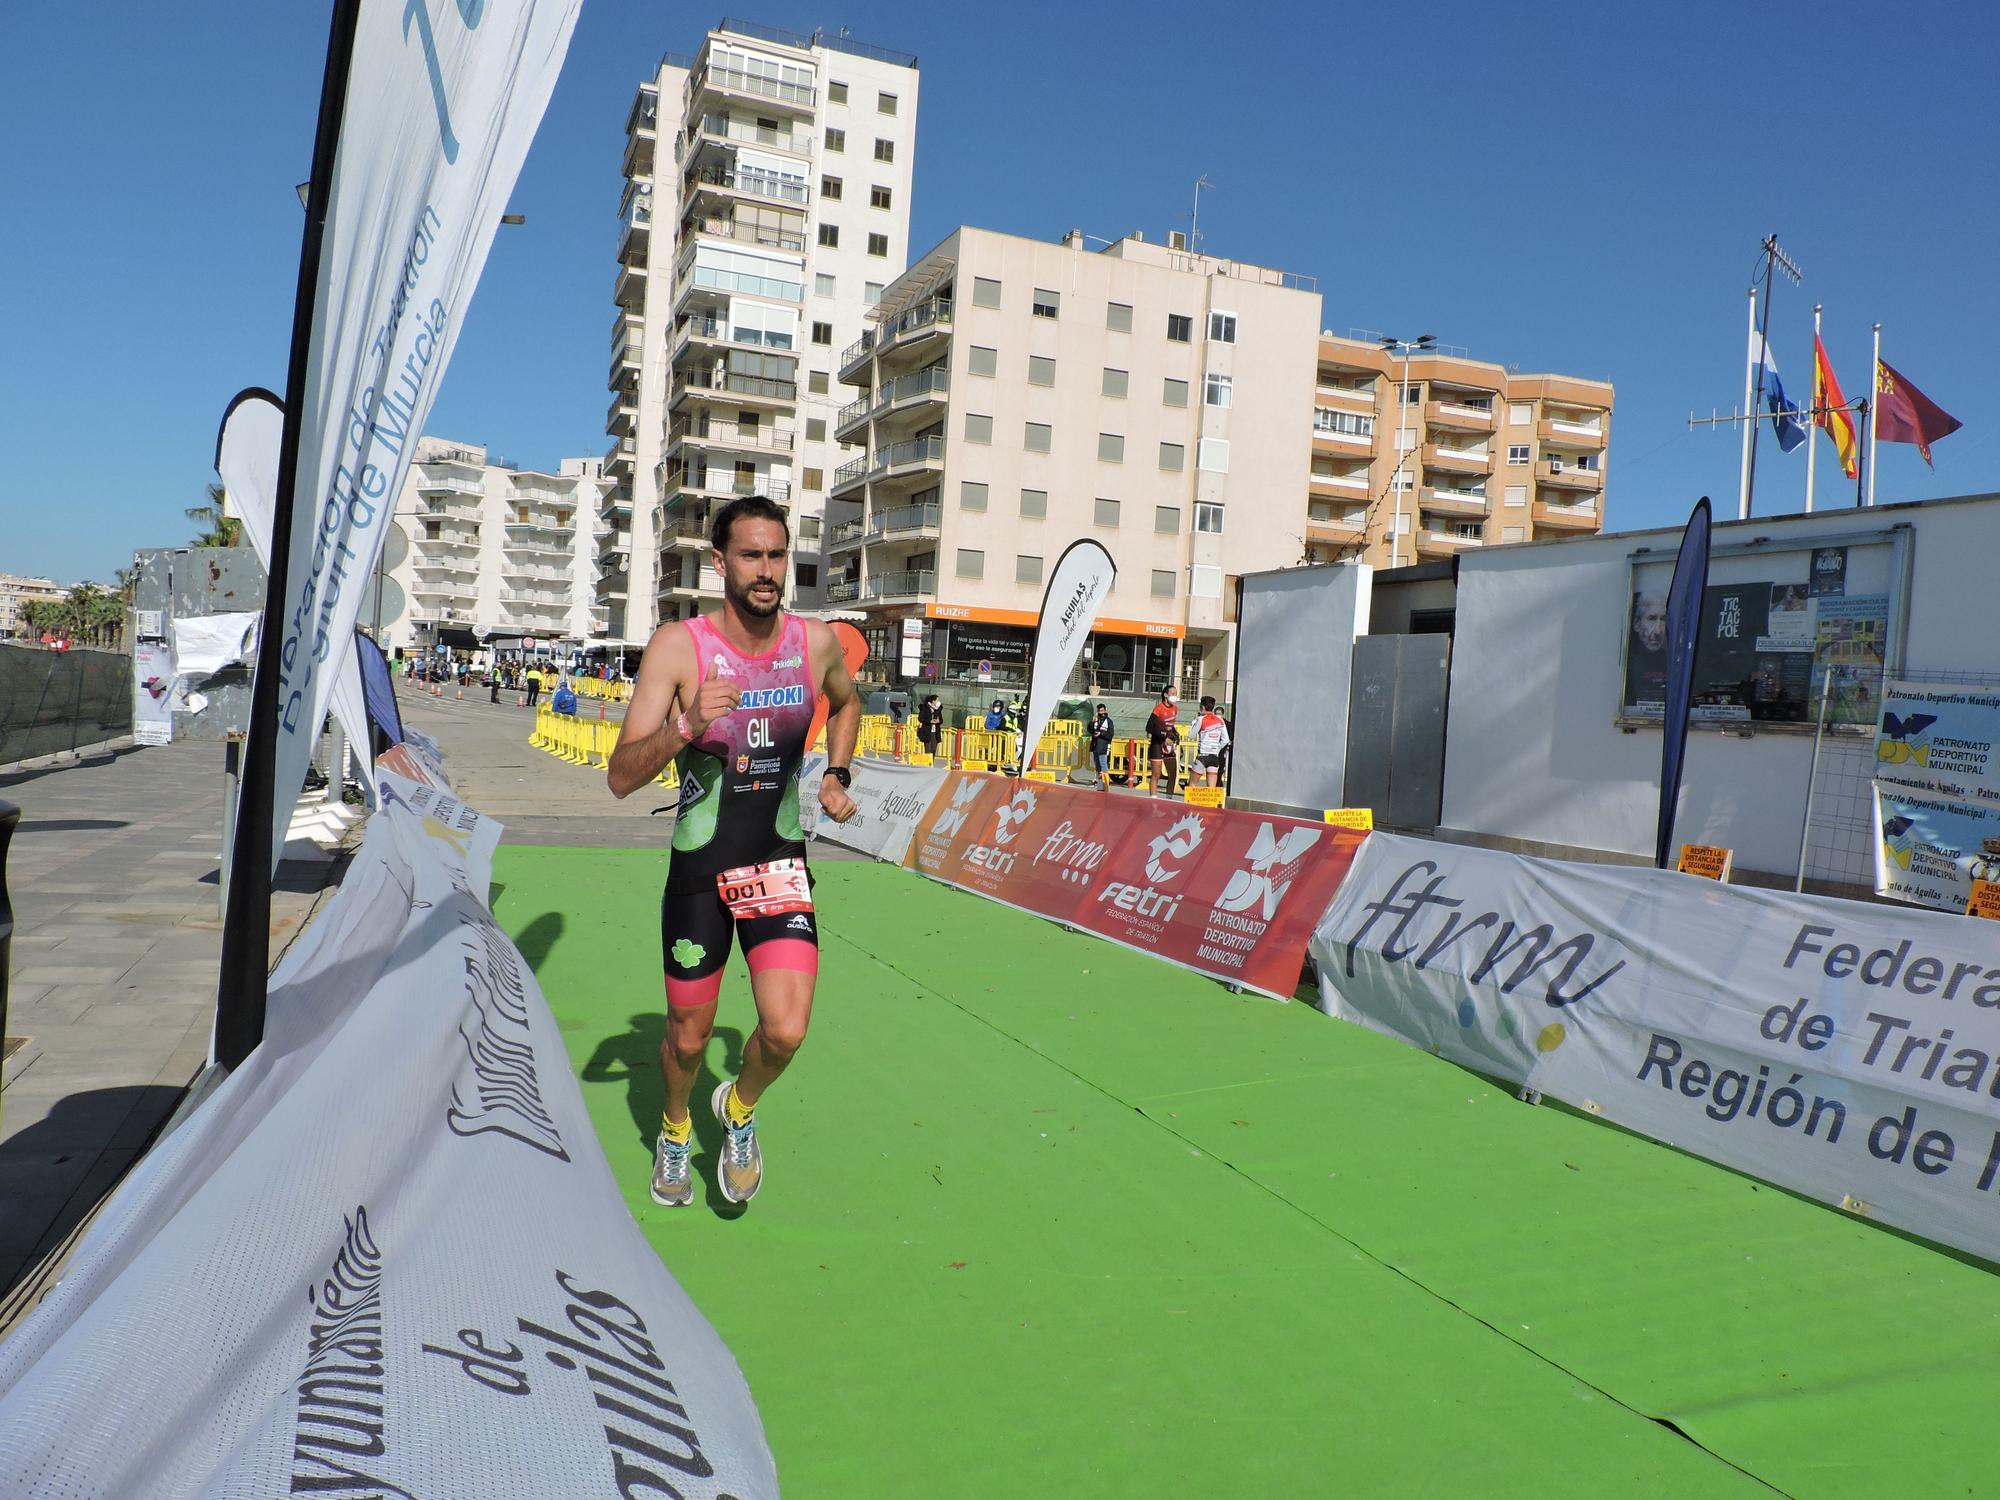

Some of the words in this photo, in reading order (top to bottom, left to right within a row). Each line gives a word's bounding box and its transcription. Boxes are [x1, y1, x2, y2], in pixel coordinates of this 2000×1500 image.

[348, 462, 386, 529] de
[369, 297, 447, 455] Murcia
[935, 606, 970, 618] RUIZRE
[1059, 617, 1077, 652] Ciudad
[1145, 624, 1177, 635] RUIZRE
[1717, 624, 1740, 639] POE
[968, 637, 983, 645] gusta
[737, 685, 804, 710] ALTOKI
[1887, 687, 1925, 701] Patronato
[1926, 692, 1966, 705] Deportivo
[747, 717, 775, 749] GIL
[1933, 736, 1991, 752] PATRONATO
[750, 760, 781, 770] Pamplona
[1930, 748, 1988, 764] DEPORTIVO
[1928, 761, 1985, 776] MUNICIPAL
[877, 785, 925, 822] Águilas
[1906, 796, 1946, 812] Deportivo
[1947, 804, 1987, 820] Municipal
[1685, 854, 1716, 864] DISTANCIA
[1690, 847, 1713, 856] RESPETE
[1914, 841, 1961, 859] PATRONATO
[1687, 861, 1720, 871] SEGURIDAD
[1912, 852, 1957, 870] DEPORTIVO
[1910, 864, 1959, 882] MUNICIPAL
[725, 881, 767, 902] 001
[1903, 883, 1913, 895] de
[1914, 882, 1942, 900] Águilas
[1105, 907, 1139, 925] FEDERACIÓN
[1138, 917, 1165, 933] ESPAÑOLA
[1209, 910, 1267, 936] PATRONATO
[1125, 927, 1133, 936] DE
[1203, 927, 1257, 952] DEPORTIVO
[1196, 944, 1245, 968] MUNICIPAL
[1759, 998, 1836, 1051] de
[1637, 1033, 1846, 1144] Región
[1867, 1105, 1955, 1175] de
[290, 1204, 415, 1500] yuntamiento
[421, 1327, 532, 1396] de
